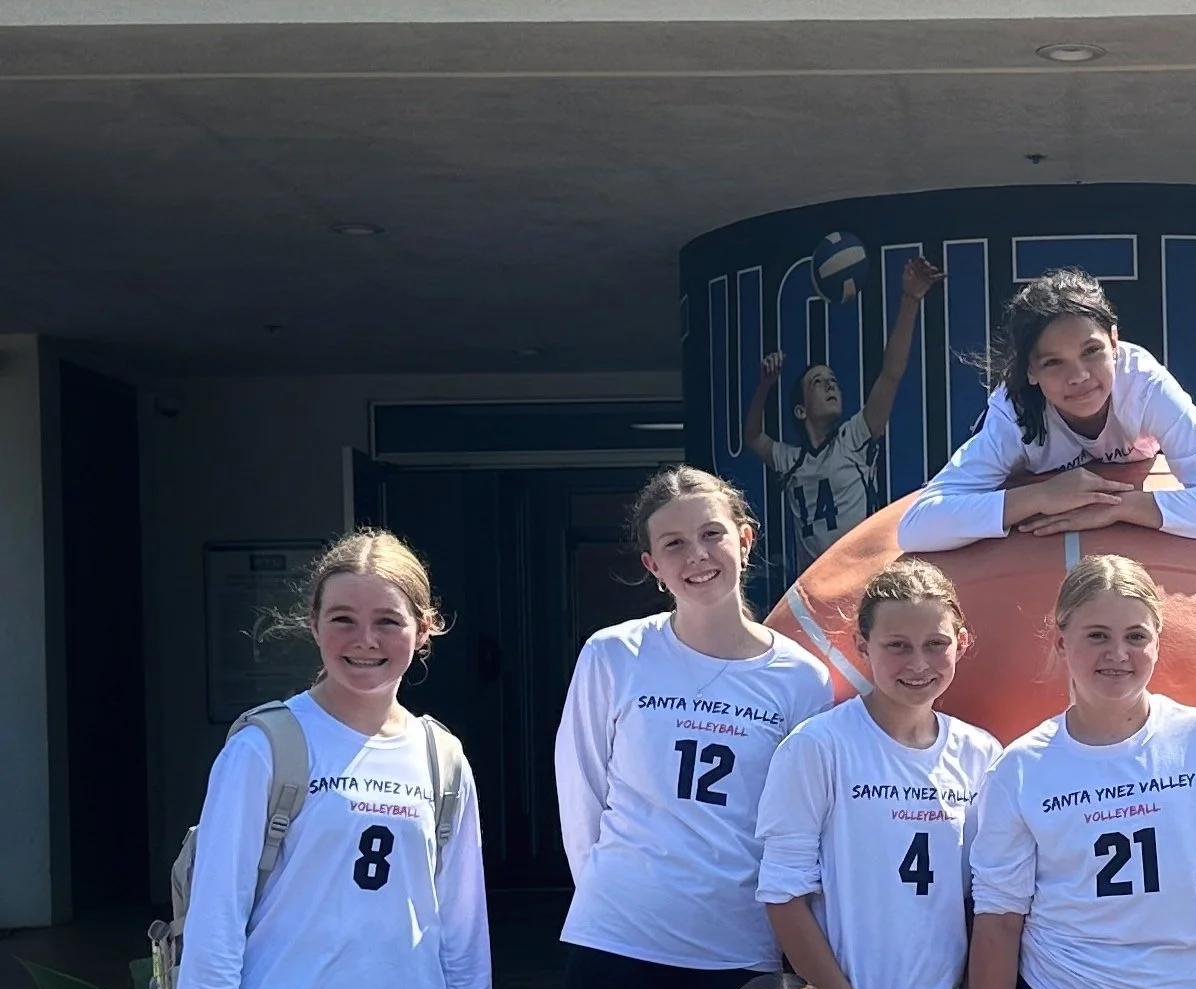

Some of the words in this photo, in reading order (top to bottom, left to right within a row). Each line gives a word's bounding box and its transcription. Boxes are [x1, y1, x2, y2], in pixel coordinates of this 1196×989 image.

[638, 695, 687, 710] SANTA
[692, 699, 731, 715] YNEZ
[676, 718, 748, 737] VOLLEYBALL
[675, 739, 736, 807] 12
[309, 776, 359, 795] SANTA
[363, 778, 401, 795] YNEZ
[405, 783, 435, 803] VALL
[852, 784, 900, 800] SANTA
[902, 786, 937, 801] YNEZ
[1042, 790, 1091, 813] SANTA
[1095, 783, 1135, 802] YNEZ
[1139, 773, 1196, 794] VALLEY
[350, 801, 420, 818] VOLLEYBALL
[892, 809, 957, 822] VOLLEYBALL
[1084, 802, 1161, 824] VOLLEYBALL
[353, 824, 395, 891] 8
[898, 832, 934, 895] 4
[1093, 827, 1160, 898] 21
